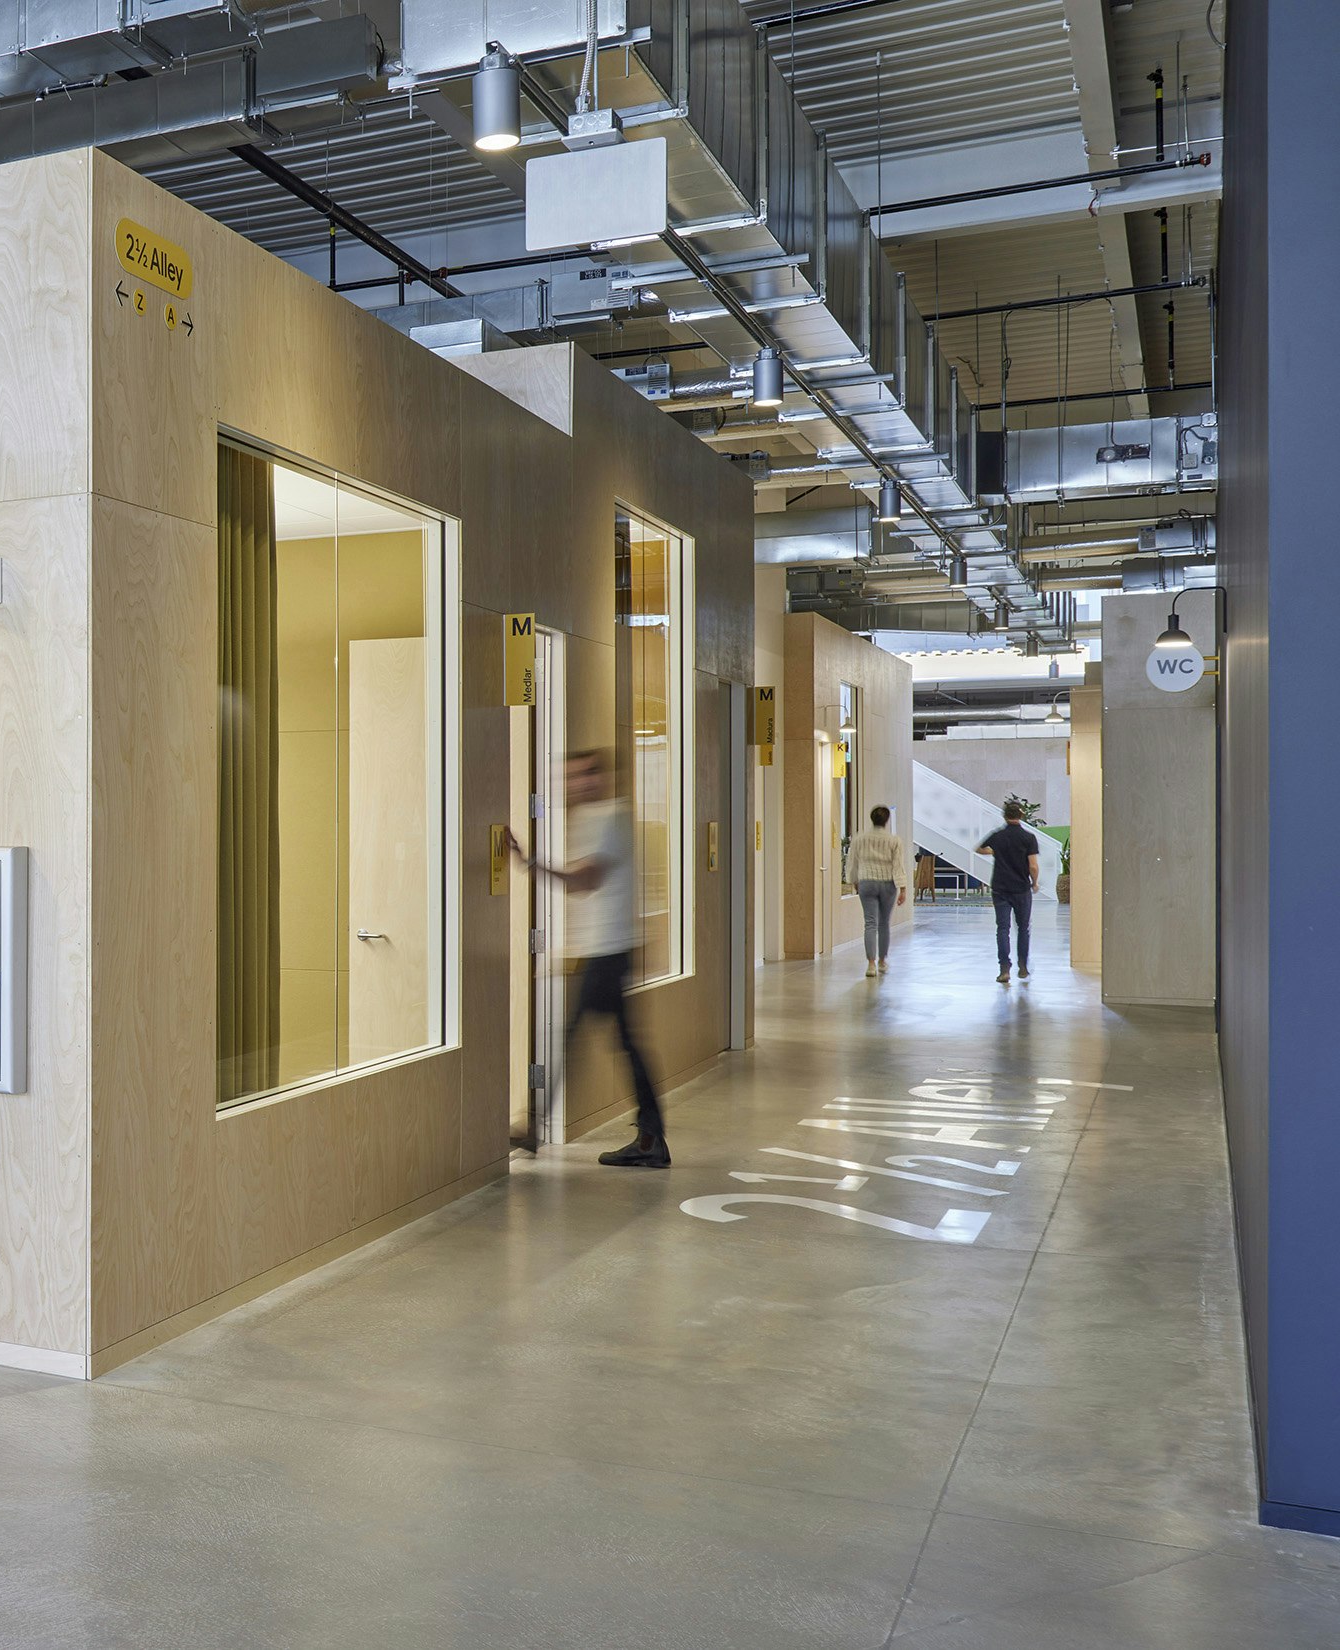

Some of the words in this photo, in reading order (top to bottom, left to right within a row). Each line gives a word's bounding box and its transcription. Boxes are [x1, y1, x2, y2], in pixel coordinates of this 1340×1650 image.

[150, 247, 184, 291] Alley
[137, 293, 144, 311] Z
[167, 307, 175, 325] A
[512, 616, 532, 636] M
[1156, 658, 1194, 675] WC
[523, 668, 533, 703] Medlar
[760, 688, 773, 701] M
[837, 743, 844, 752] K
